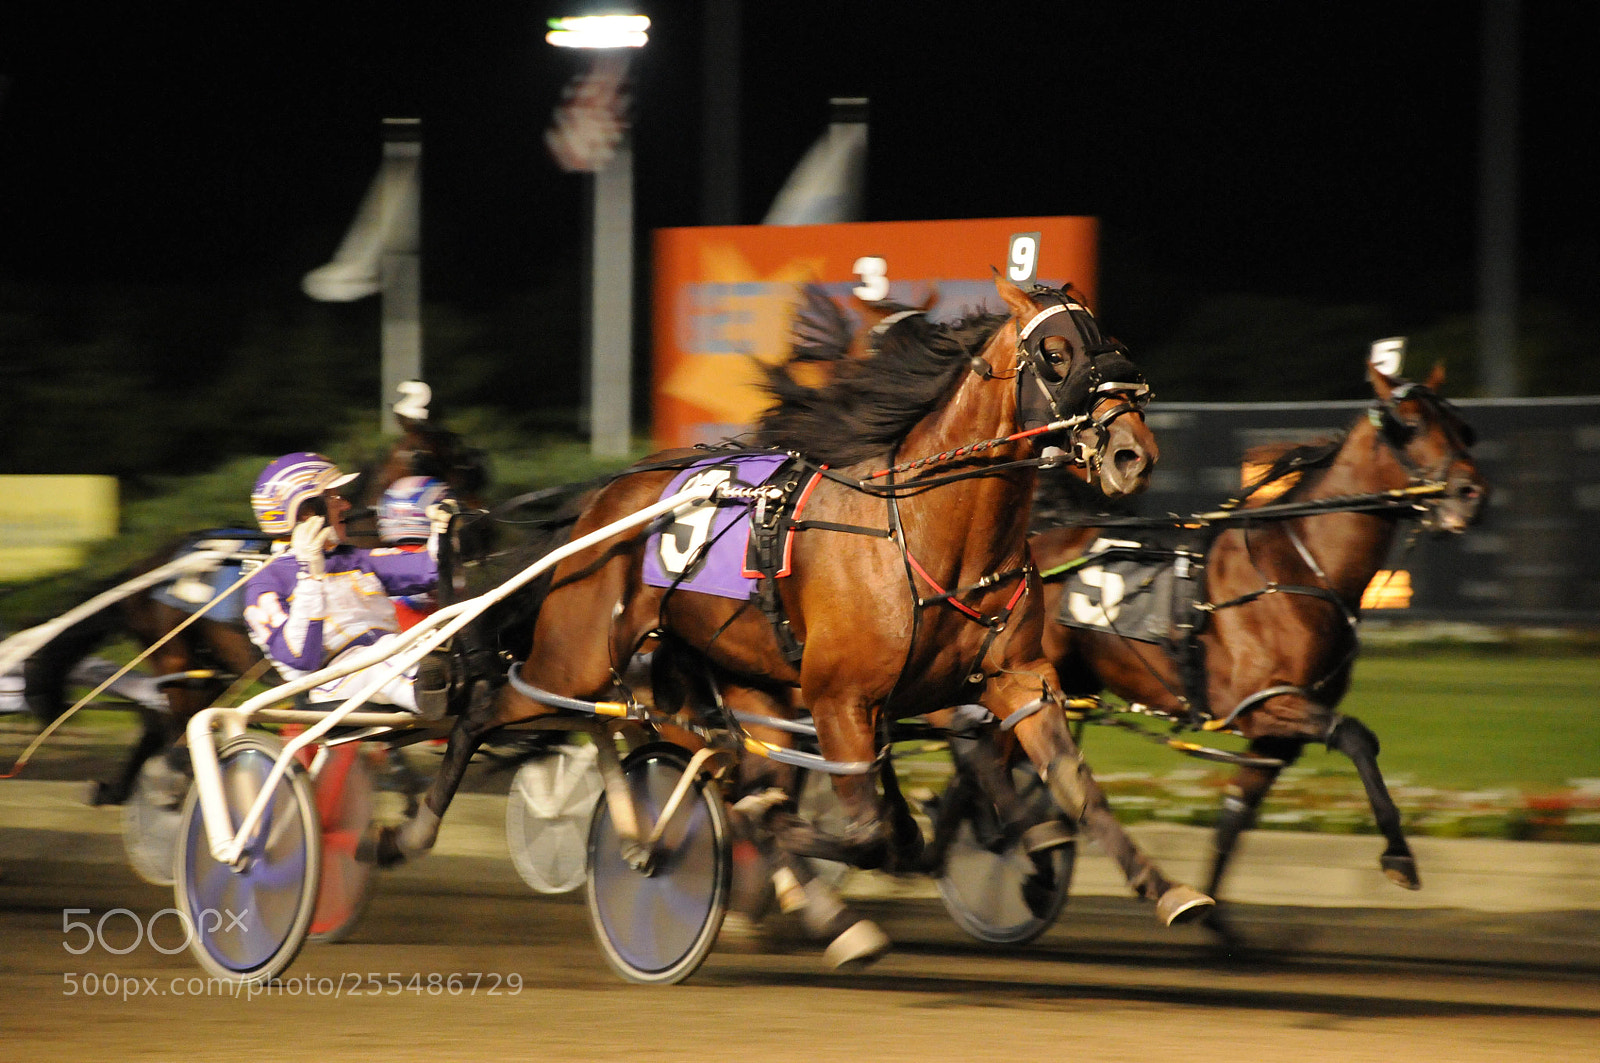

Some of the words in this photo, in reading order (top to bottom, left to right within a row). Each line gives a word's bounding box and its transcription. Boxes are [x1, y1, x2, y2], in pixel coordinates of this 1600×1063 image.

[852, 256, 889, 301] 3
[1009, 236, 1036, 281] 9
[1371, 338, 1405, 376] 5
[393, 381, 432, 419] 2
